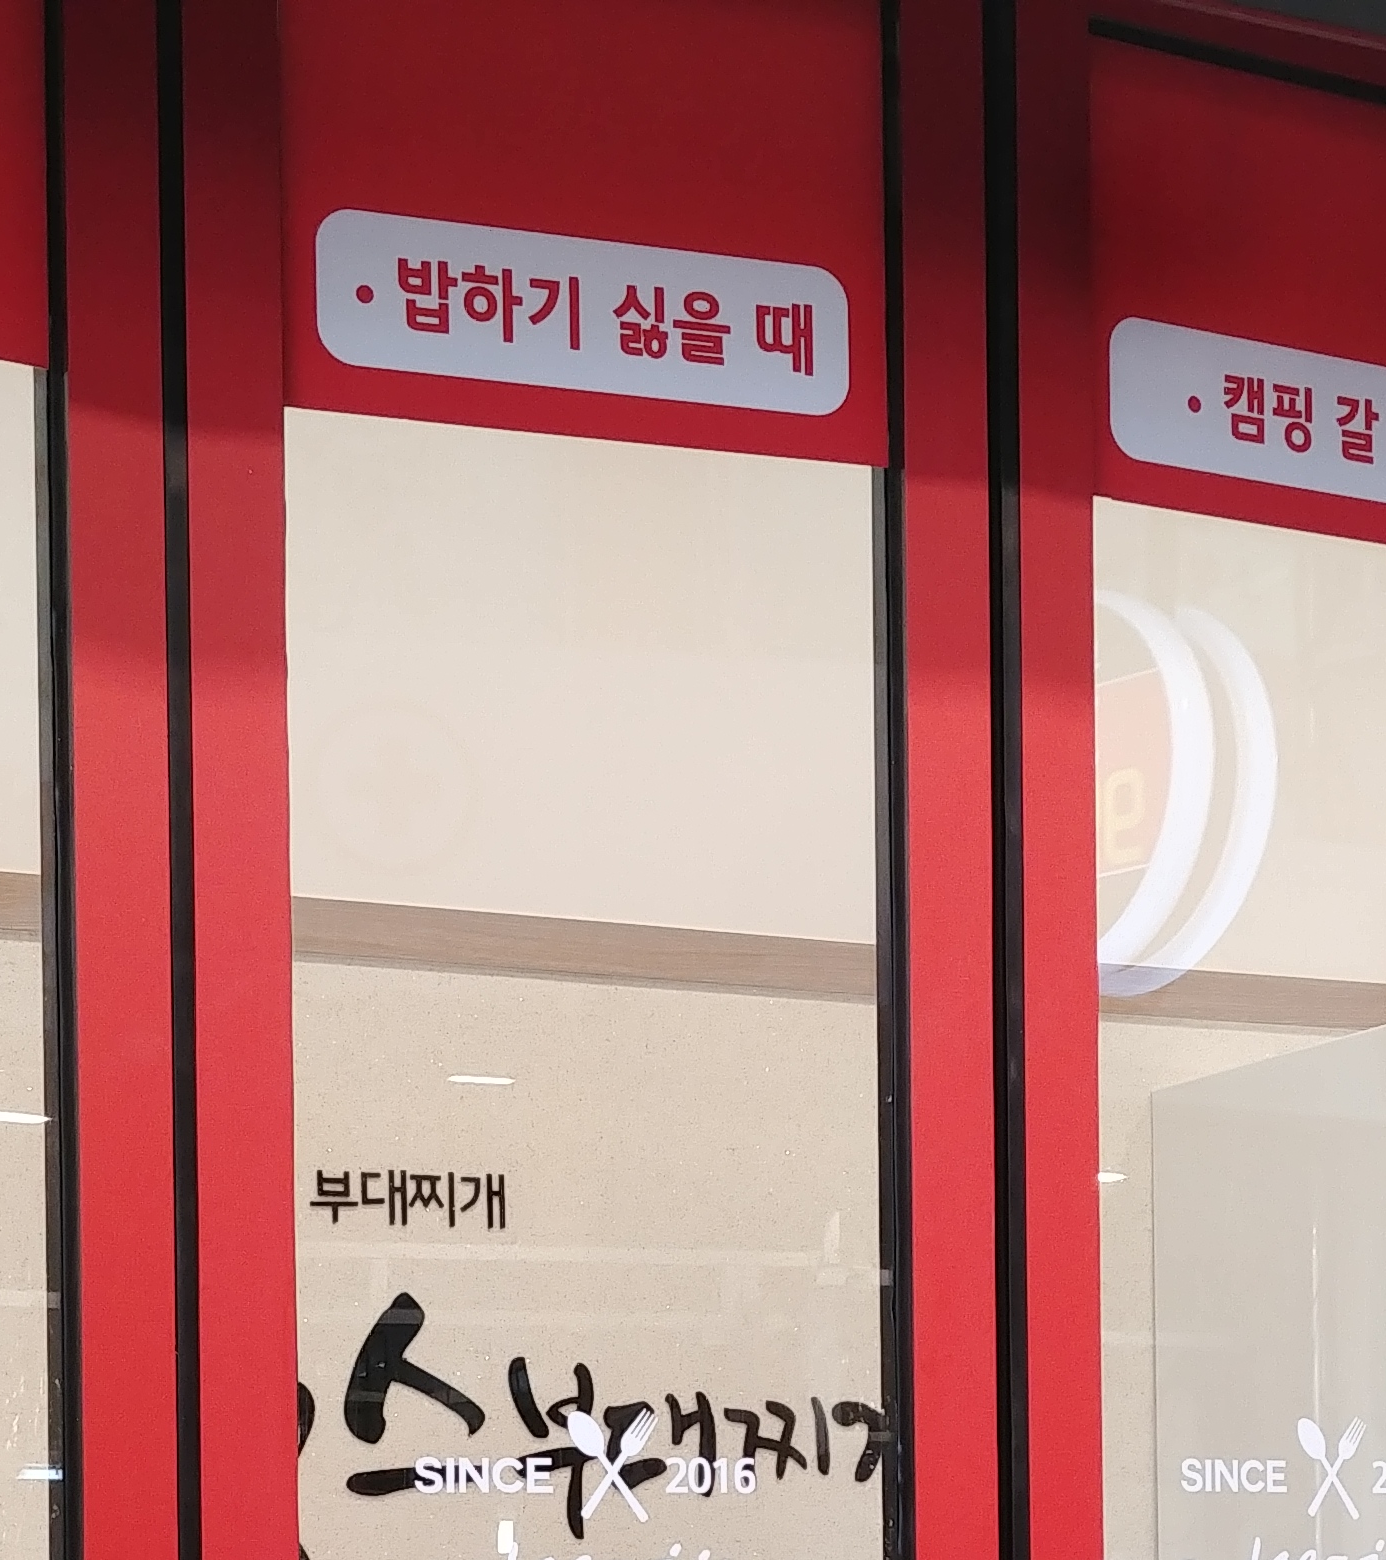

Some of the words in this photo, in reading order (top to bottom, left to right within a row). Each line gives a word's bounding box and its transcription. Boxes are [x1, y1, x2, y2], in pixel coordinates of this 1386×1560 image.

[396, 256, 582, 351] 밥하기
[612, 283, 732, 367] 싫을
[754, 301, 815, 377] 때
[1222, 373, 1314, 454] 캠핑
[1335, 395, 1381, 466] 갈
[309, 1169, 507, 1230] 부대찌개
[413, 1455, 554, 1496] SINCE
[664, 1456, 758, 1496] 2016
[1180, 1457, 1288, 1494] SINCE
